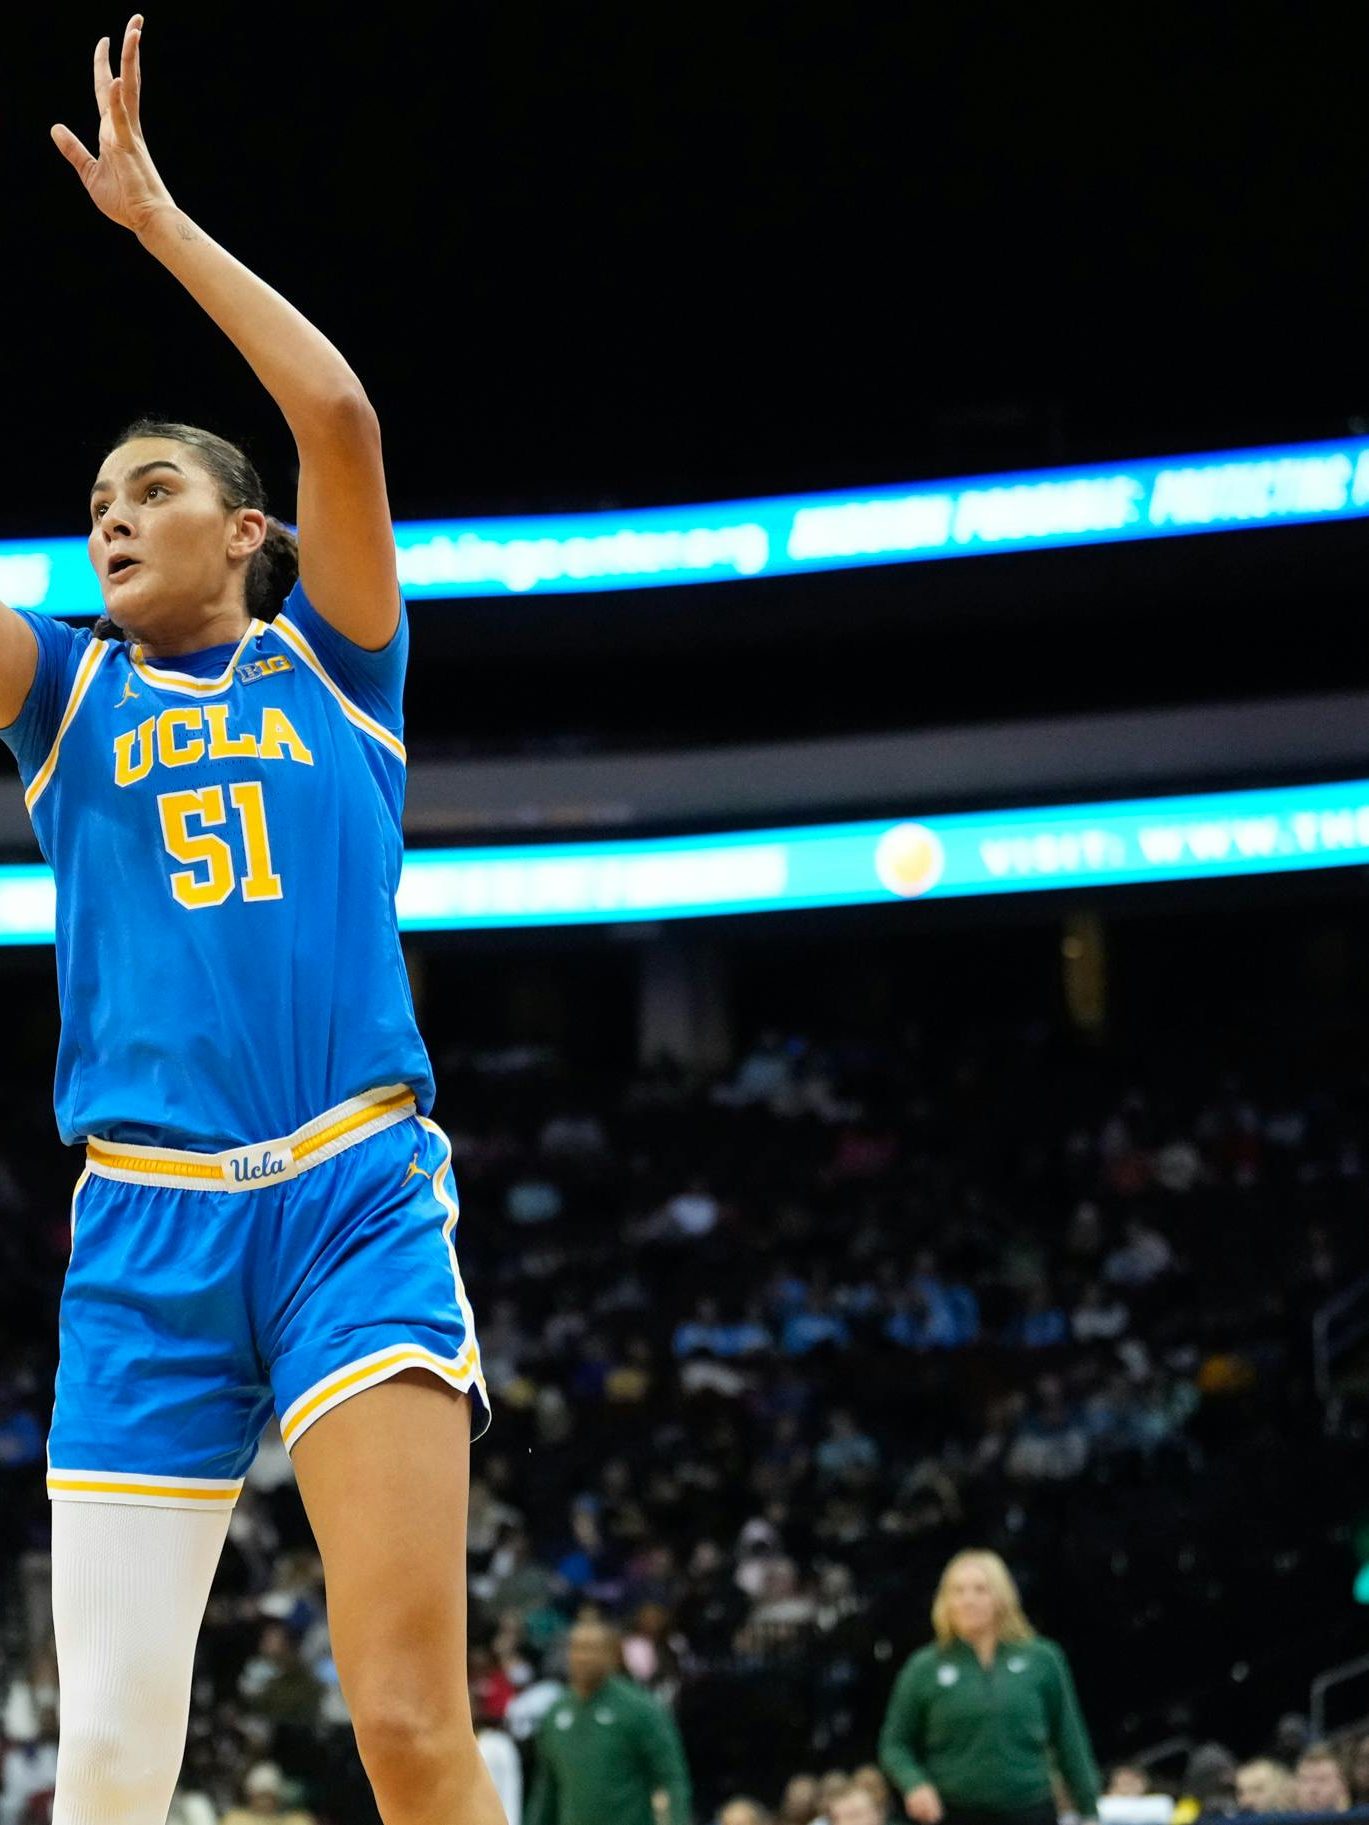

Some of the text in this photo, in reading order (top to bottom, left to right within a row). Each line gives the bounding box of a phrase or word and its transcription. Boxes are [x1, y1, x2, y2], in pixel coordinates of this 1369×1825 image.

[113, 704, 314, 788] UCLA
[156, 780, 283, 911] 51
[230, 1151, 286, 1182] Ucla
